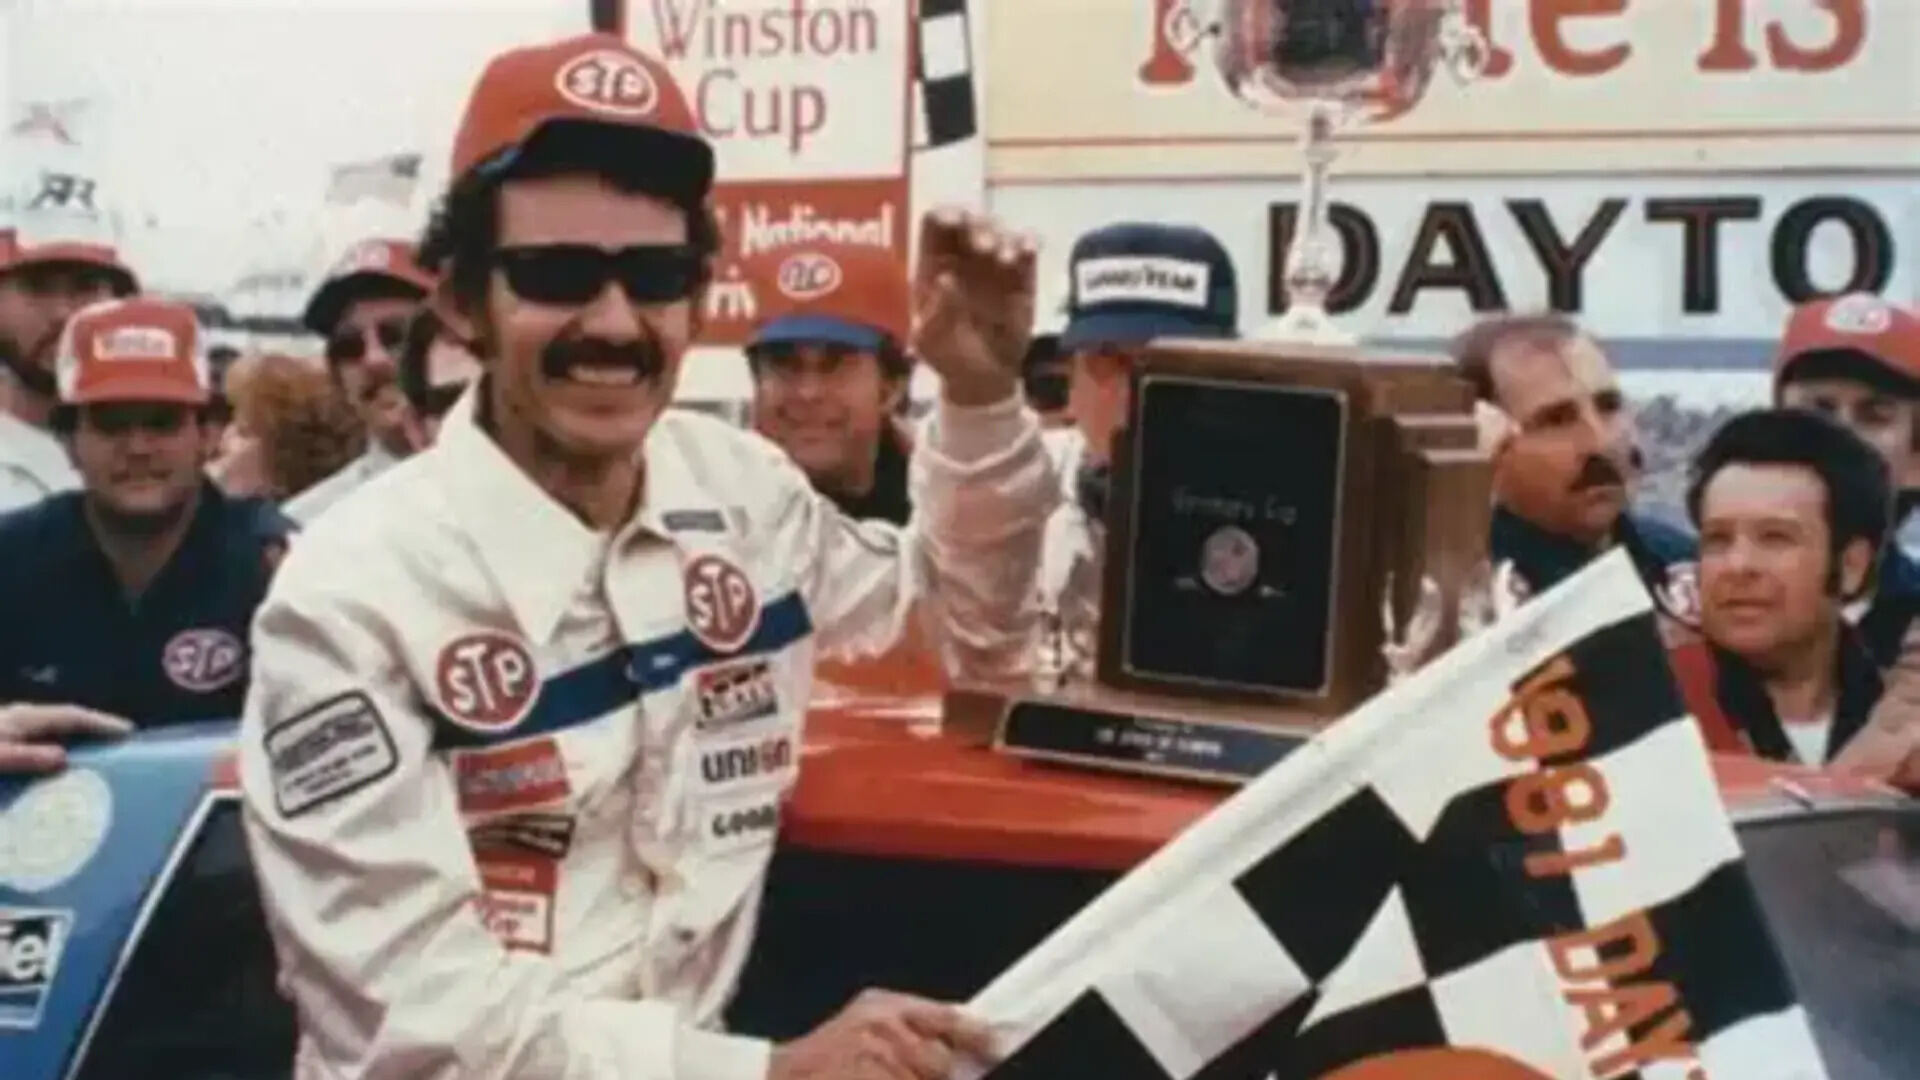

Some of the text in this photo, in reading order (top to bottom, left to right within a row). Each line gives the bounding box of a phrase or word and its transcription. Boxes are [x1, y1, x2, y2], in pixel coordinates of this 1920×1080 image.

[652, 0, 879, 60] Winston
[570, 59, 648, 100] STP
[697, 68, 828, 154] Cup
[740, 201, 893, 257] National
[689, 563, 748, 633] STP
[167, 640, 236, 680] STP
[446, 644, 528, 712] STP
[1488, 654, 1625, 877] 1981
